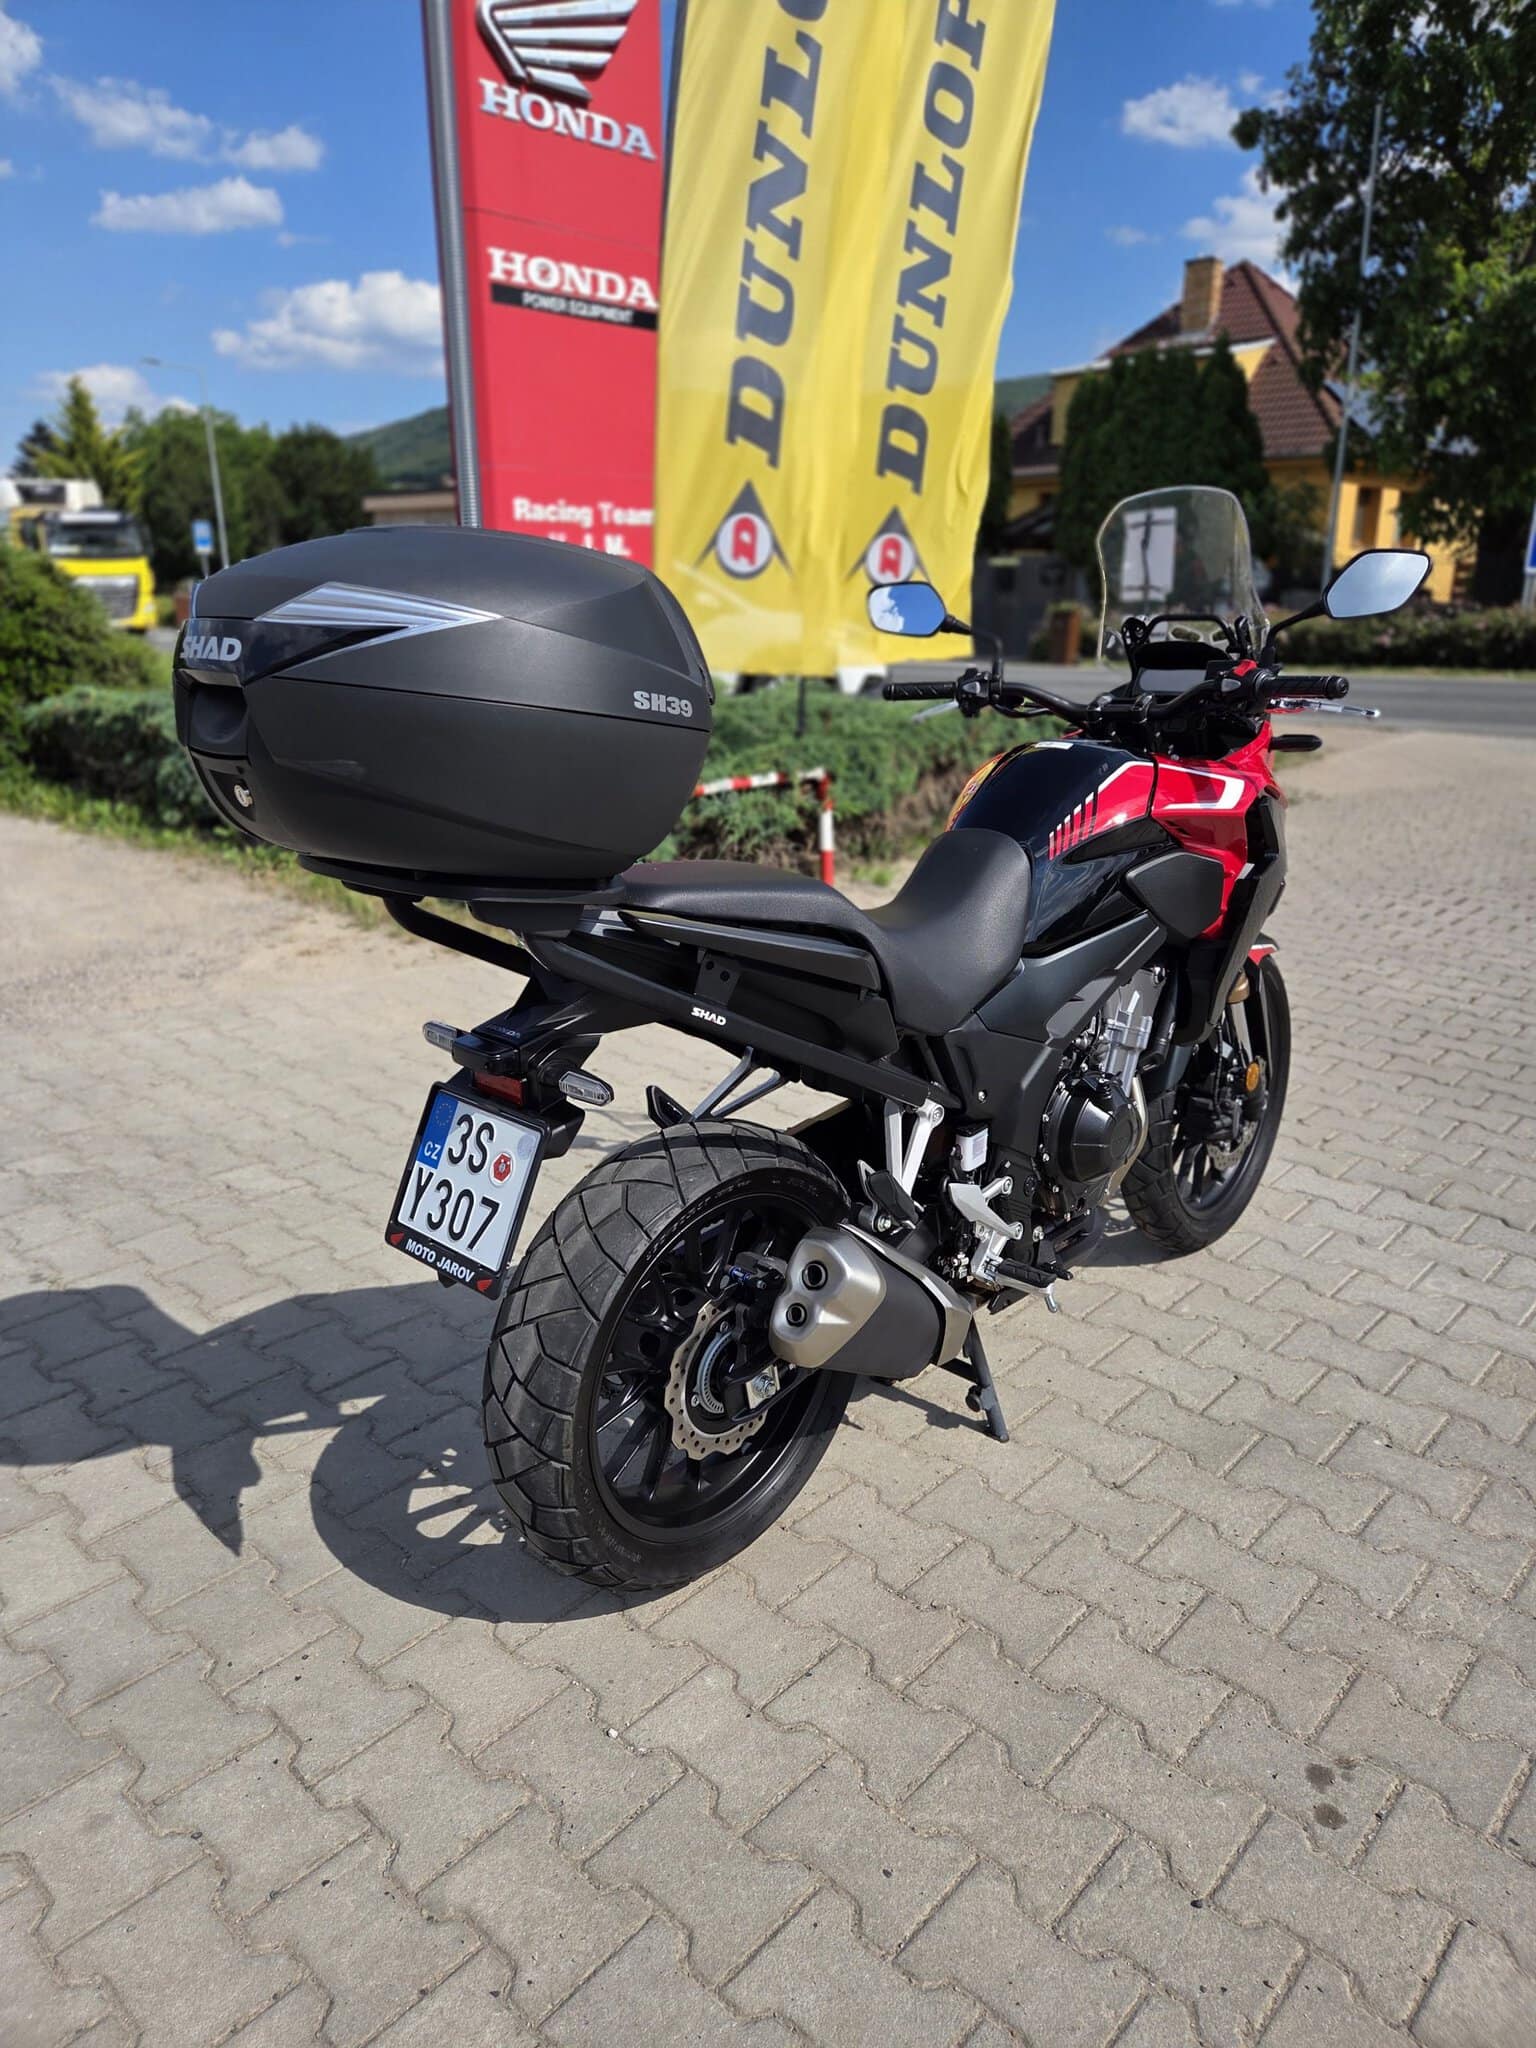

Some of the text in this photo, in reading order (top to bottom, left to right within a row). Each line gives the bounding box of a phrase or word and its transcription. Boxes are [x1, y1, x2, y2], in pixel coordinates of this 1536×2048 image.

[478, 78, 657, 160] HONDA
[723, 0, 829, 470] DUNL
[876, 0, 986, 496] DUNLOP
[487, 246, 659, 309] HONDA
[521, 291, 634, 323] POWER EQUIPMENT
[512, 496, 656, 528] Racing Team
[180, 635, 242, 662] SHAD
[633, 690, 693, 718] SH39
[691, 1006, 727, 1026] SHAD
[424, 1141, 442, 1160] CZ
[448, 1114, 495, 1173] 3S
[408, 1167, 500, 1250] Y307
[405, 1238, 475, 1283] MOTO JAROV
